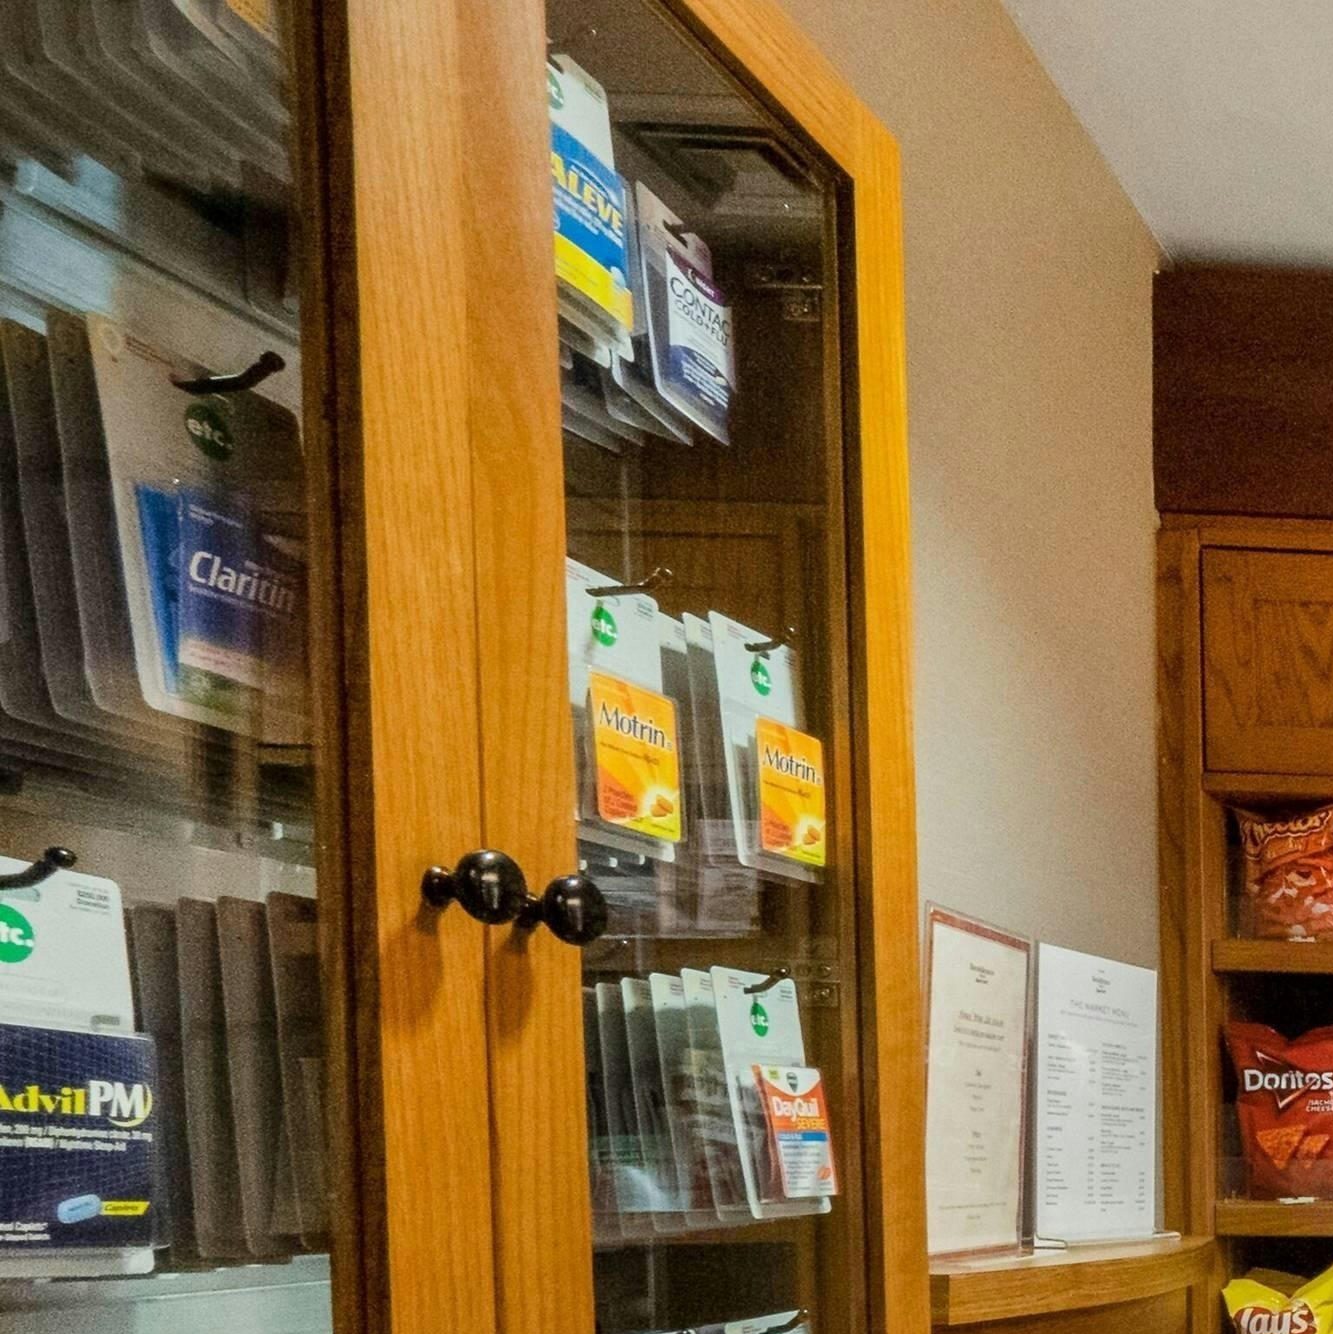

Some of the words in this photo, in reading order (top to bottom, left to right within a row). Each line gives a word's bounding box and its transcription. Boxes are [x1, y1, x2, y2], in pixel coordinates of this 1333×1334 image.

[551, 152, 624, 235] ALEVE
[670, 277, 731, 337] CONTAC
[187, 417, 232, 448] etc.
[188, 550, 295, 613] Claritin
[591, 618, 617, 639] etc.
[600, 703, 666, 749] Motrin
[763, 747, 816, 785] Motrin
[0, 921, 34, 947] tc.
[89, 1080, 145, 1118] PM
